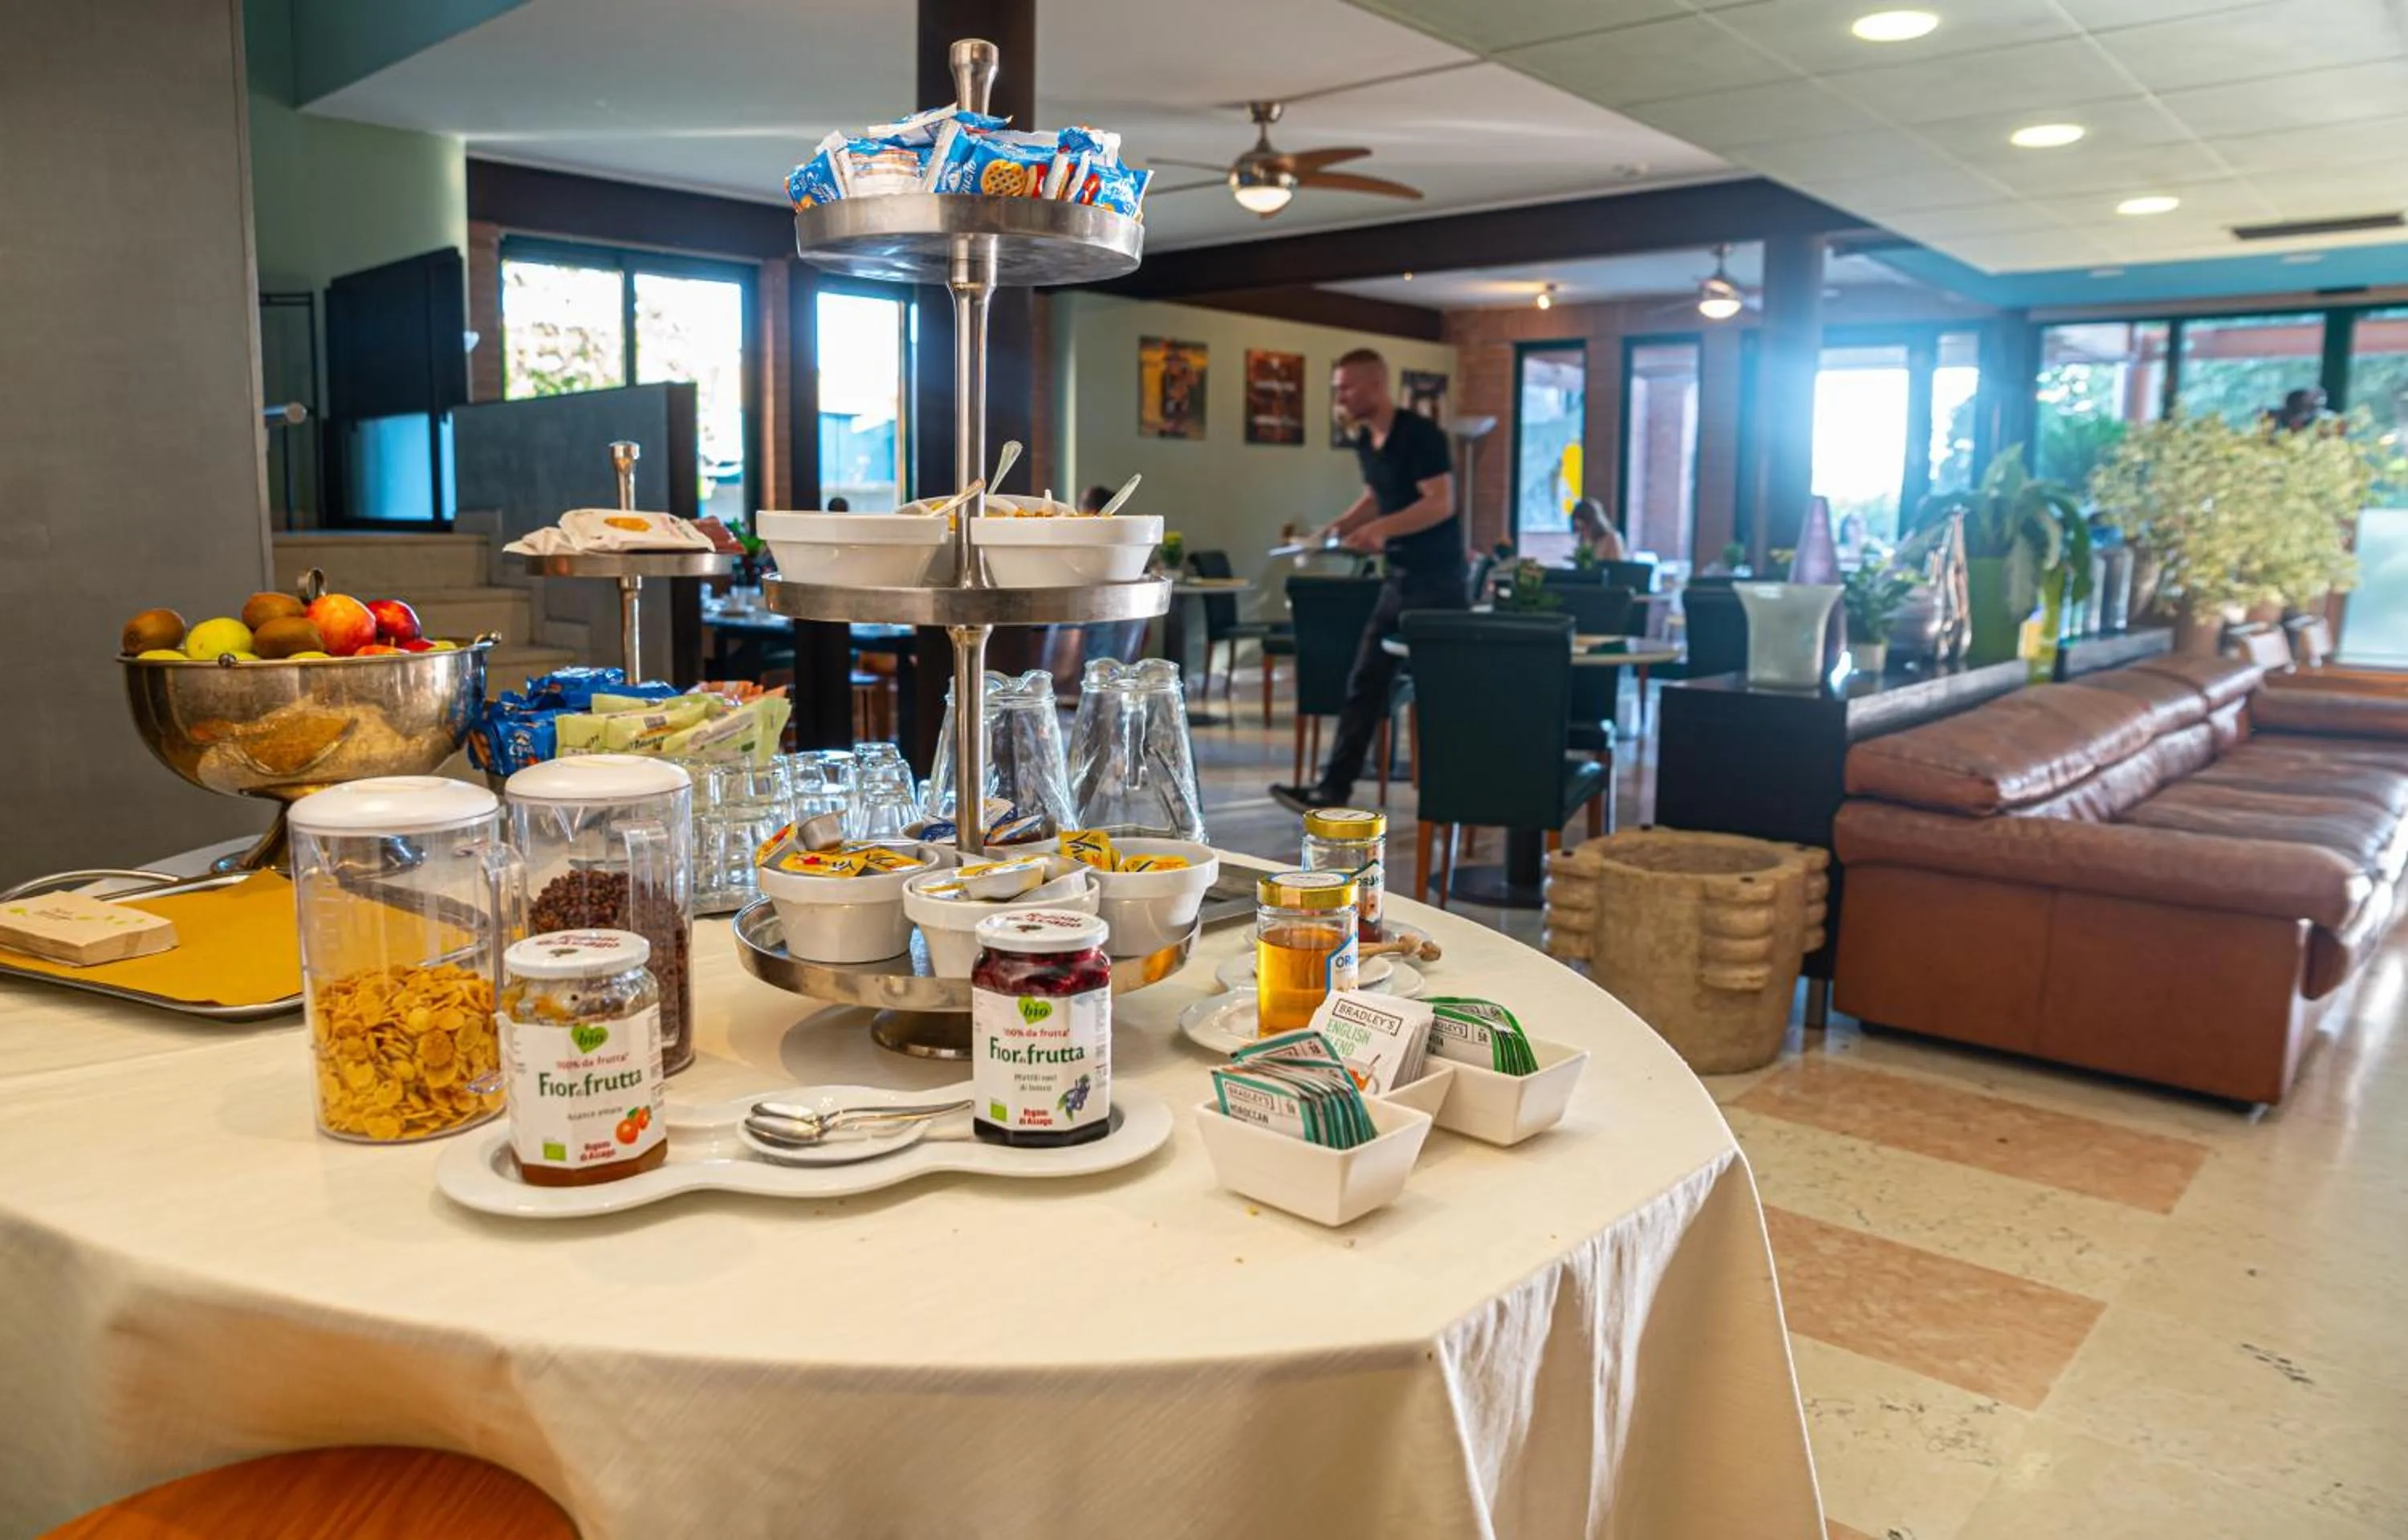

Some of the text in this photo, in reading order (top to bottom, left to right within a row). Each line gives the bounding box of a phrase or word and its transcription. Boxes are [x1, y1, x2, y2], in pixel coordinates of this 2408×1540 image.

[1025, 1003, 1048, 1016] bio
[1339, 1003, 1395, 1030] BRADLEY'S
[579, 1031, 604, 1045] bio
[1326, 1018, 1372, 1045] ENGLISH
[1327, 1034, 1355, 1057] END
